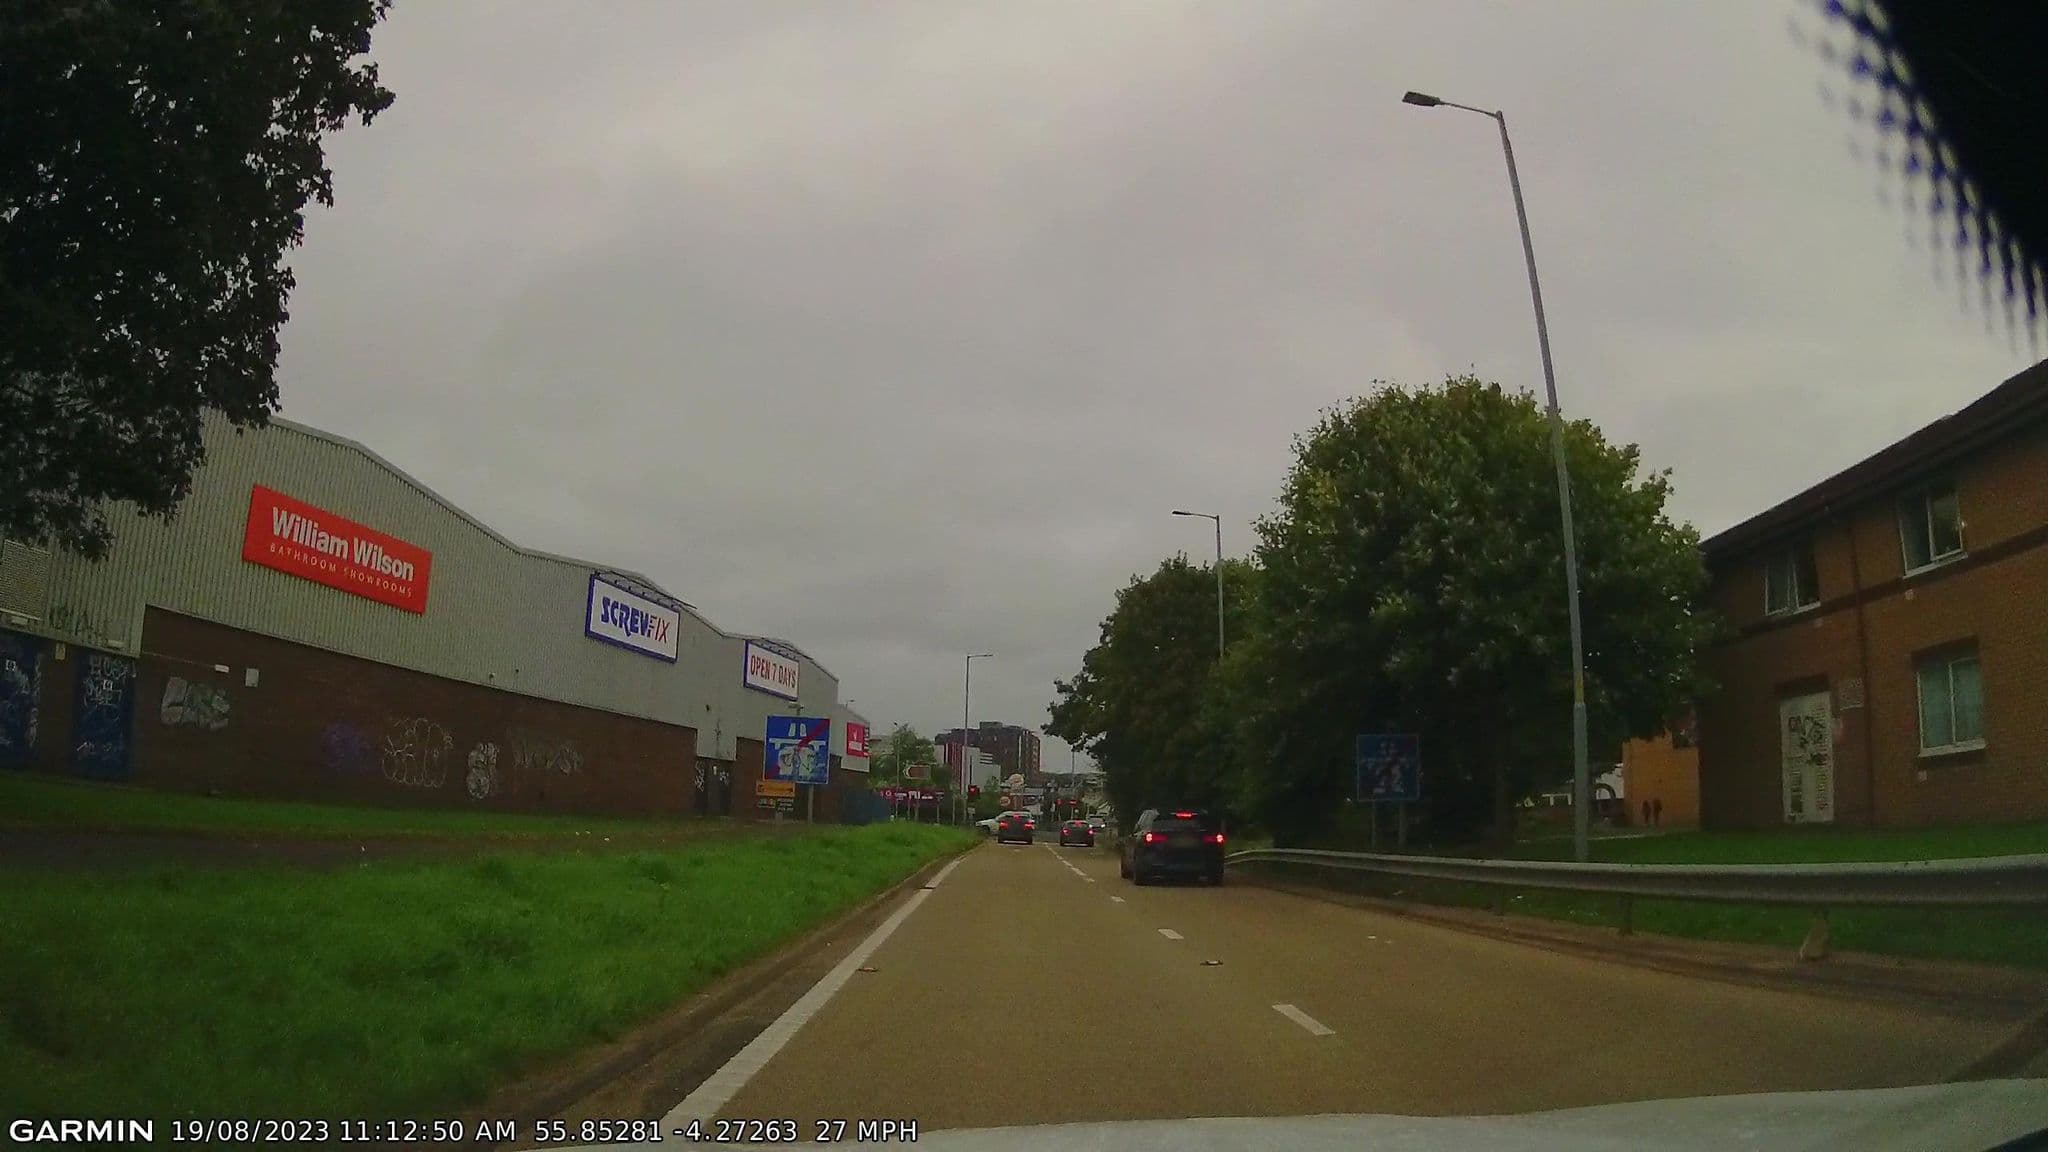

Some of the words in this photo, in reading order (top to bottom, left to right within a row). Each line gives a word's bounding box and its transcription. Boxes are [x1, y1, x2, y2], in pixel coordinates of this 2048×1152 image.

[270, 542, 337, 573] BATHROOM
[343, 567, 412, 598] SHOWROOMS
[272, 506, 349, 560] William
[352, 536, 414, 582] Wilson
[750, 654, 771, 680] OPEN
[778, 665, 797, 689] DAYS
